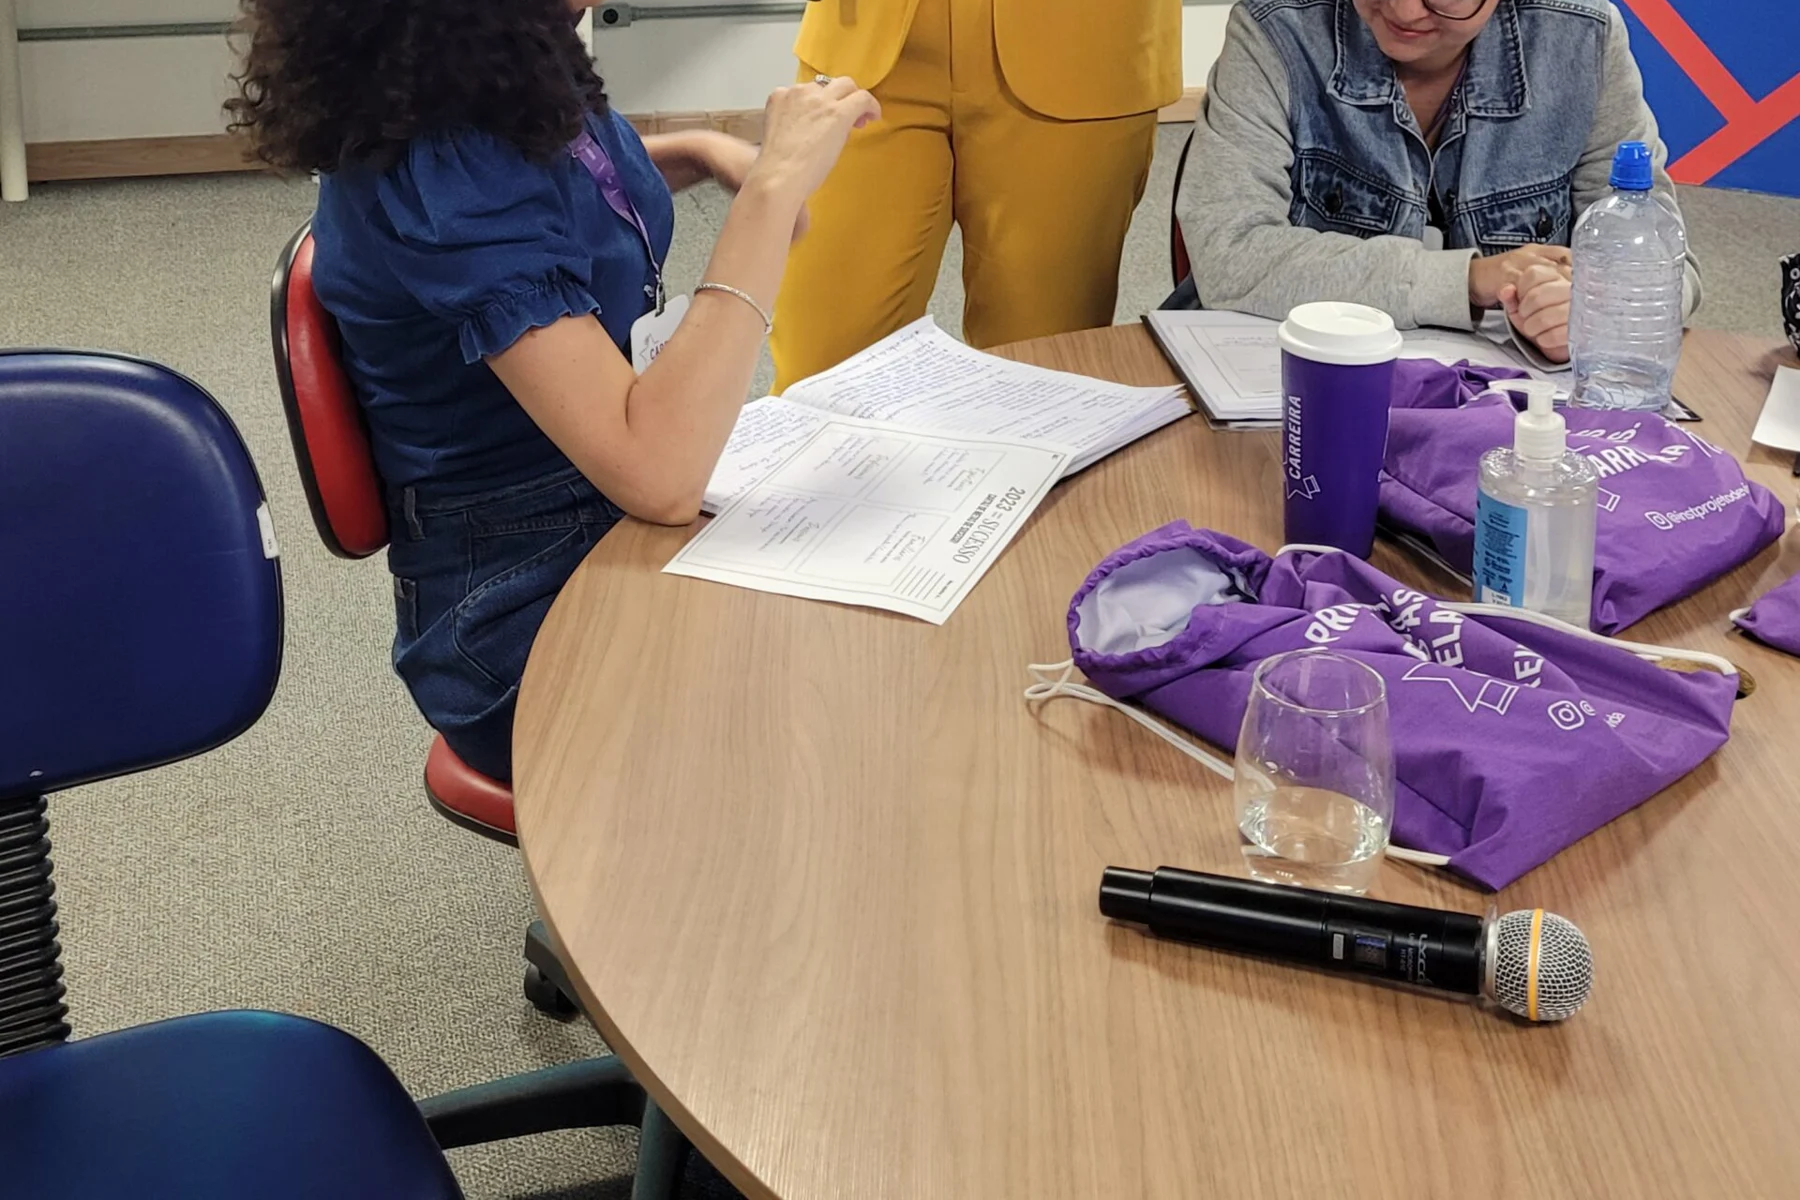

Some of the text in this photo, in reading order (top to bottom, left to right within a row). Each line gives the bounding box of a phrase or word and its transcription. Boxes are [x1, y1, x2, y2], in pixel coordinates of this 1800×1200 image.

[1288, 395, 1302, 480] CARREIRA
[995, 486, 1026, 512] 2023
[952, 518, 1000, 564] SUCESSO
